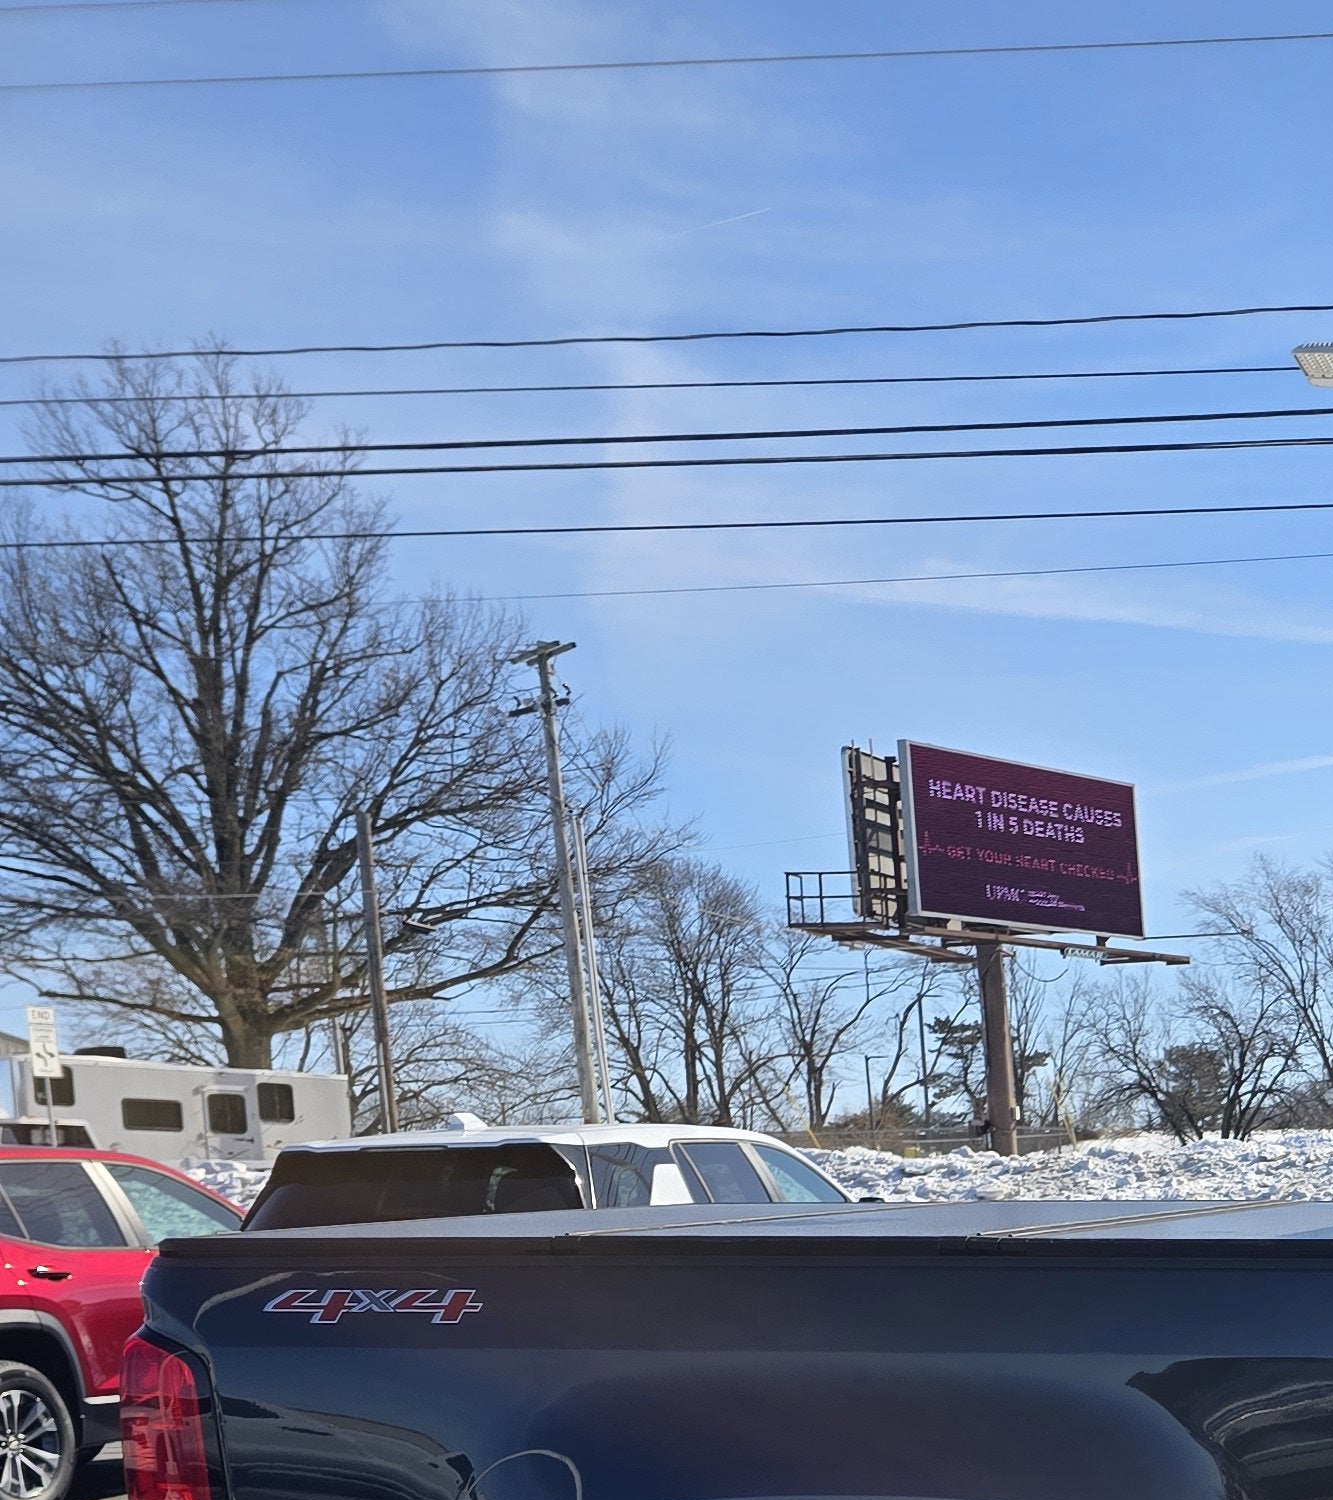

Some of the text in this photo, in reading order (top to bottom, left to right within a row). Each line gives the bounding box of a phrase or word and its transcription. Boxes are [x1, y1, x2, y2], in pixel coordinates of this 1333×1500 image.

[928, 778, 1122, 827] HEART DISEASE CAUSES
[975, 810, 1085, 844] 1 IN 5 DEATHS
[946, 845, 973, 861] GET
[976, 848, 1012, 867] YOUR
[1015, 854, 1056, 872] HEART
